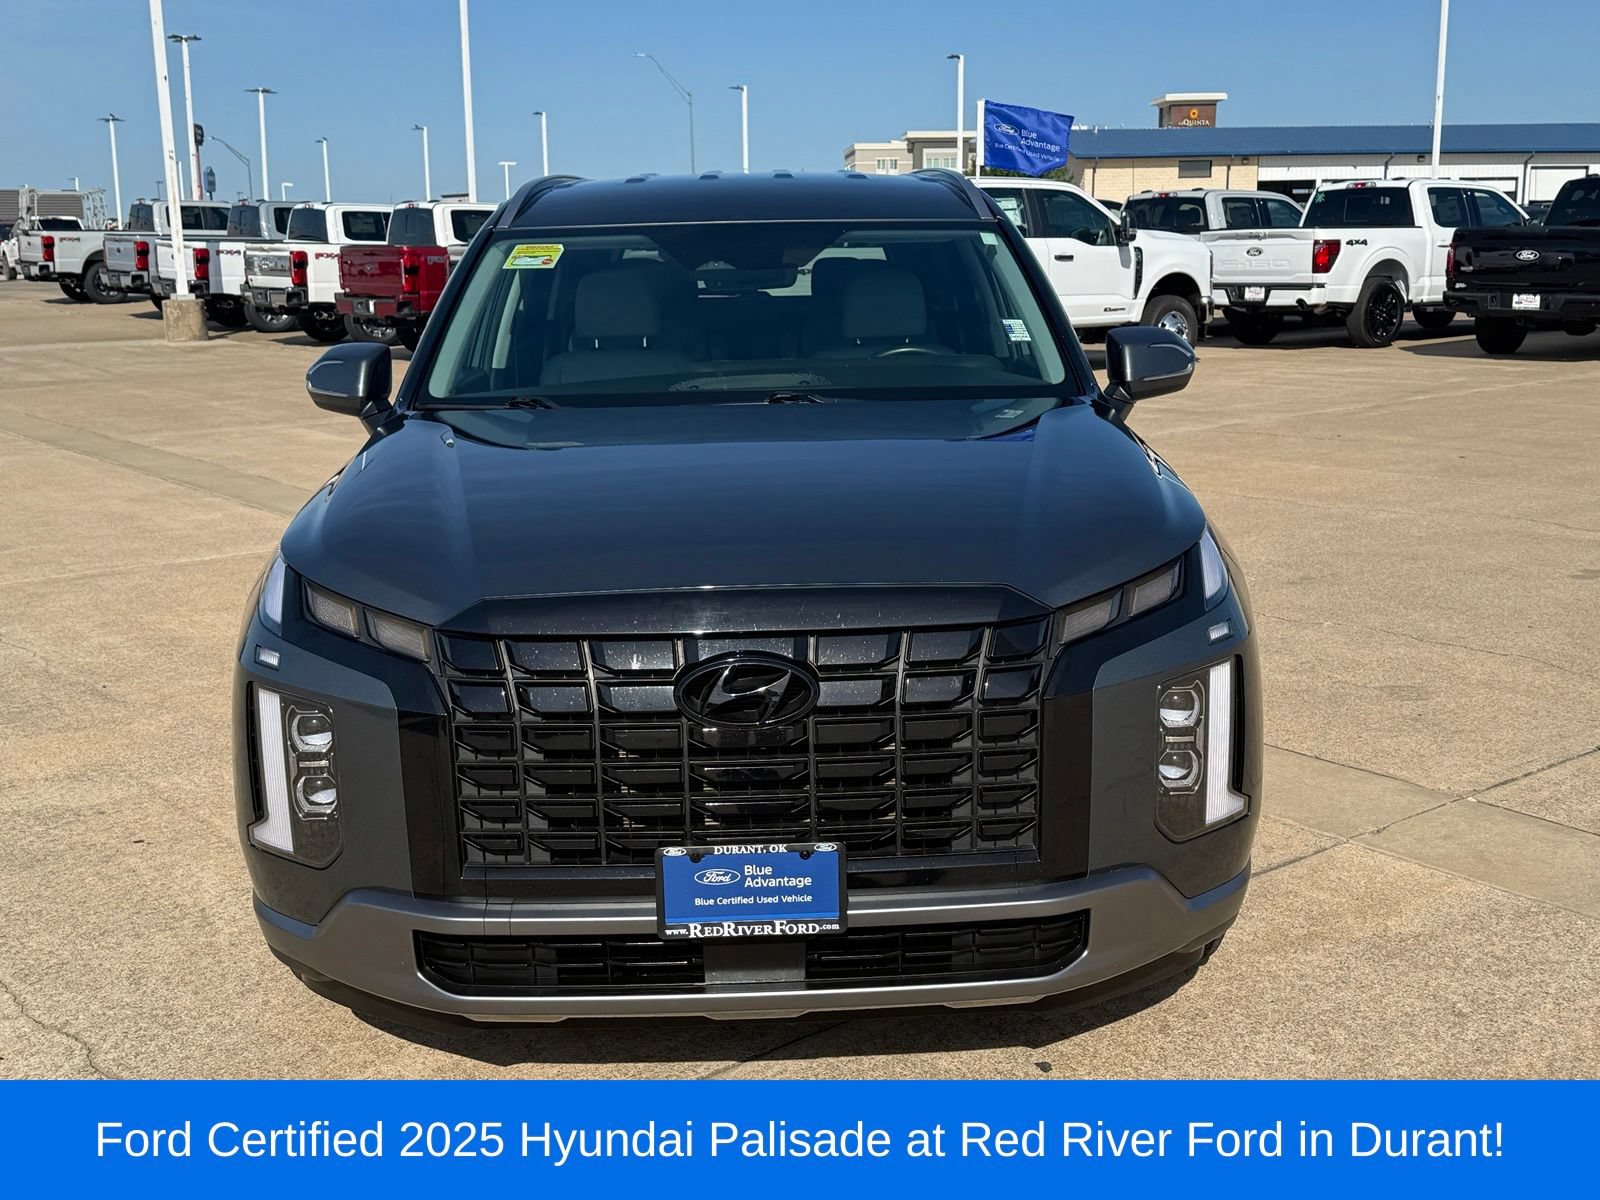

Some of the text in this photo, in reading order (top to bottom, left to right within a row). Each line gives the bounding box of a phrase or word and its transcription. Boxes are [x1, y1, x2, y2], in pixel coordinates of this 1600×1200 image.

[1183, 118, 1210, 126] QUINTA
[1021, 129, 1038, 139] Blue
[1020, 138, 1061, 153] Advantage
[1345, 238, 1368, 247] 4X4
[713, 843, 789, 855] DURANT, OK
[744, 865, 773, 876] Blue
[703, 871, 732, 883] Ford
[744, 876, 813, 888] Advantage
[694, 893, 813, 906] Blue Certified Used Vehicle
